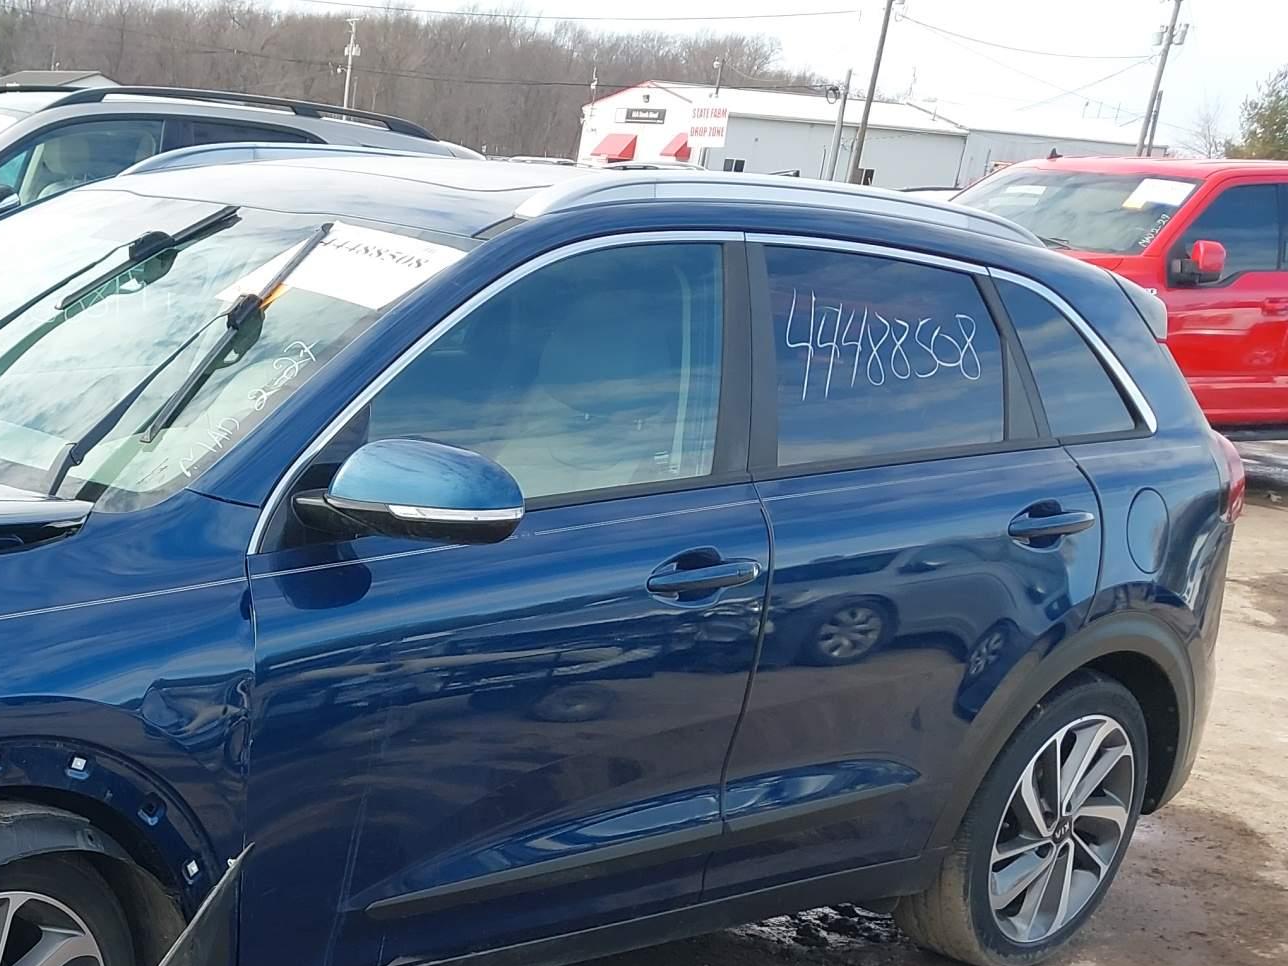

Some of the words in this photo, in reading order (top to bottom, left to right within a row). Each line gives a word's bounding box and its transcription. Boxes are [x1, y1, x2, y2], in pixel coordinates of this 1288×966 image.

[692, 107, 709, 119] STATE
[710, 107, 727, 119] FARM
[690, 126, 707, 137] DROP
[708, 126, 724, 137] ZONE
[786, 287, 981, 400] 44488508
